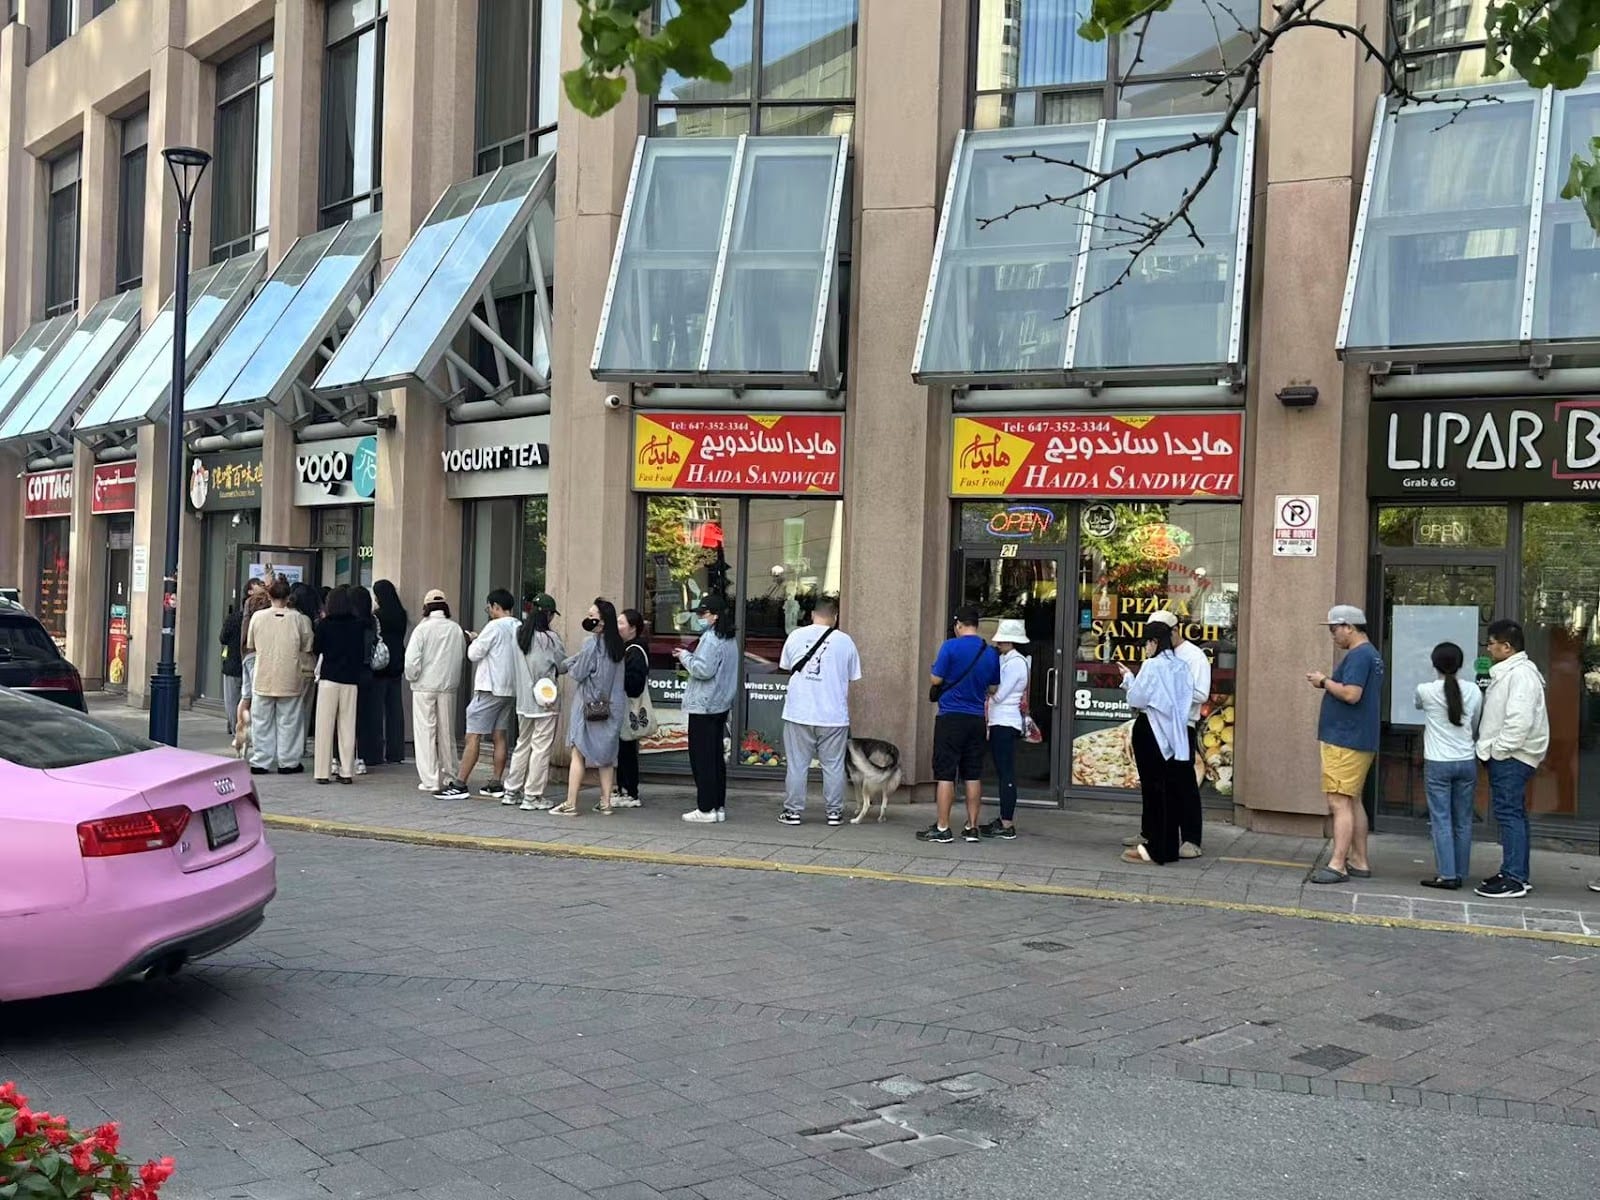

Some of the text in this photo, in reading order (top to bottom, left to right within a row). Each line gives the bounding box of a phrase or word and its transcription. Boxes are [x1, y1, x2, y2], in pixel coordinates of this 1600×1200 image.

[671, 421, 687, 431] Tel:
[688, 420, 749, 431] 647-352-3344
[1002, 421, 1110, 432] Tel: 647-352-3344
[1388, 410, 1543, 469] LIPAR
[687, 463, 835, 485] HAIDA SANDWICH
[960, 477, 1006, 487] Fast Food
[1023, 464, 1233, 490] HAIDA SANDWICH
[1402, 478, 1456, 488] Grab & Go
[28, 473, 72, 501] COTTAG
[990, 512, 1050, 532] OPEN
[1420, 523, 1464, 538] OPEN
[1121, 597, 1190, 616] PIZZA
[744, 682, 773, 690] What's
[1075, 689, 1130, 710] 8 Toppin
